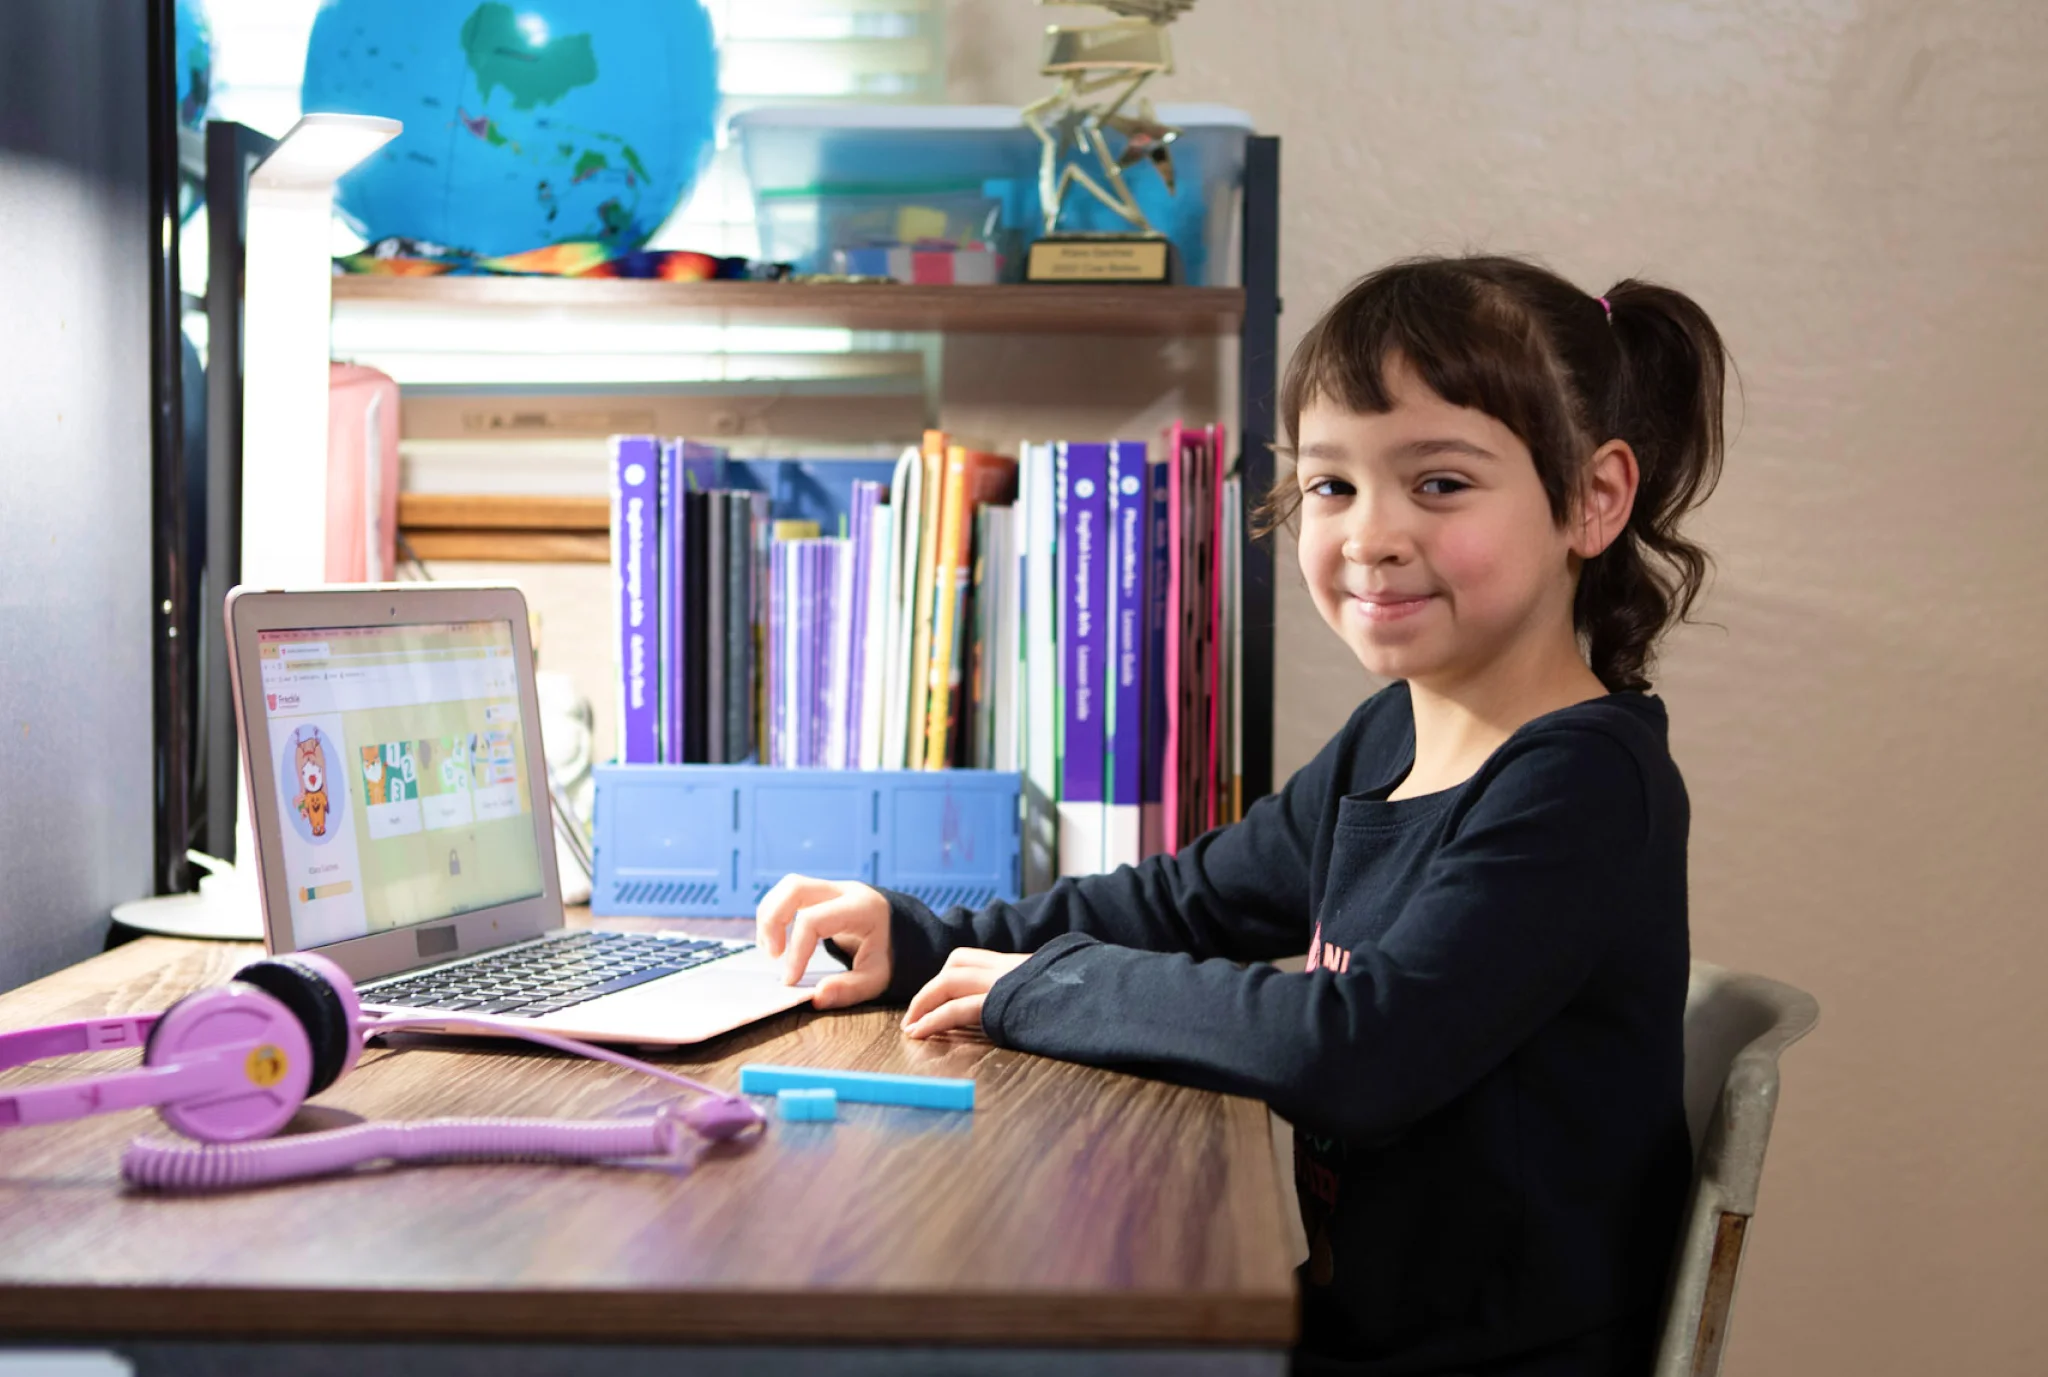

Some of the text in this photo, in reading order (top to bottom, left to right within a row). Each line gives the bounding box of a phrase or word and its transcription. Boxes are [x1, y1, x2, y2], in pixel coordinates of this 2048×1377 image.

[1075, 510, 1092, 721] English Language Arts Lesson Guide
[1122, 608, 1135, 650] Lesson
[1121, 652, 1135, 687] Guide
[404, 758, 412, 778] 2
